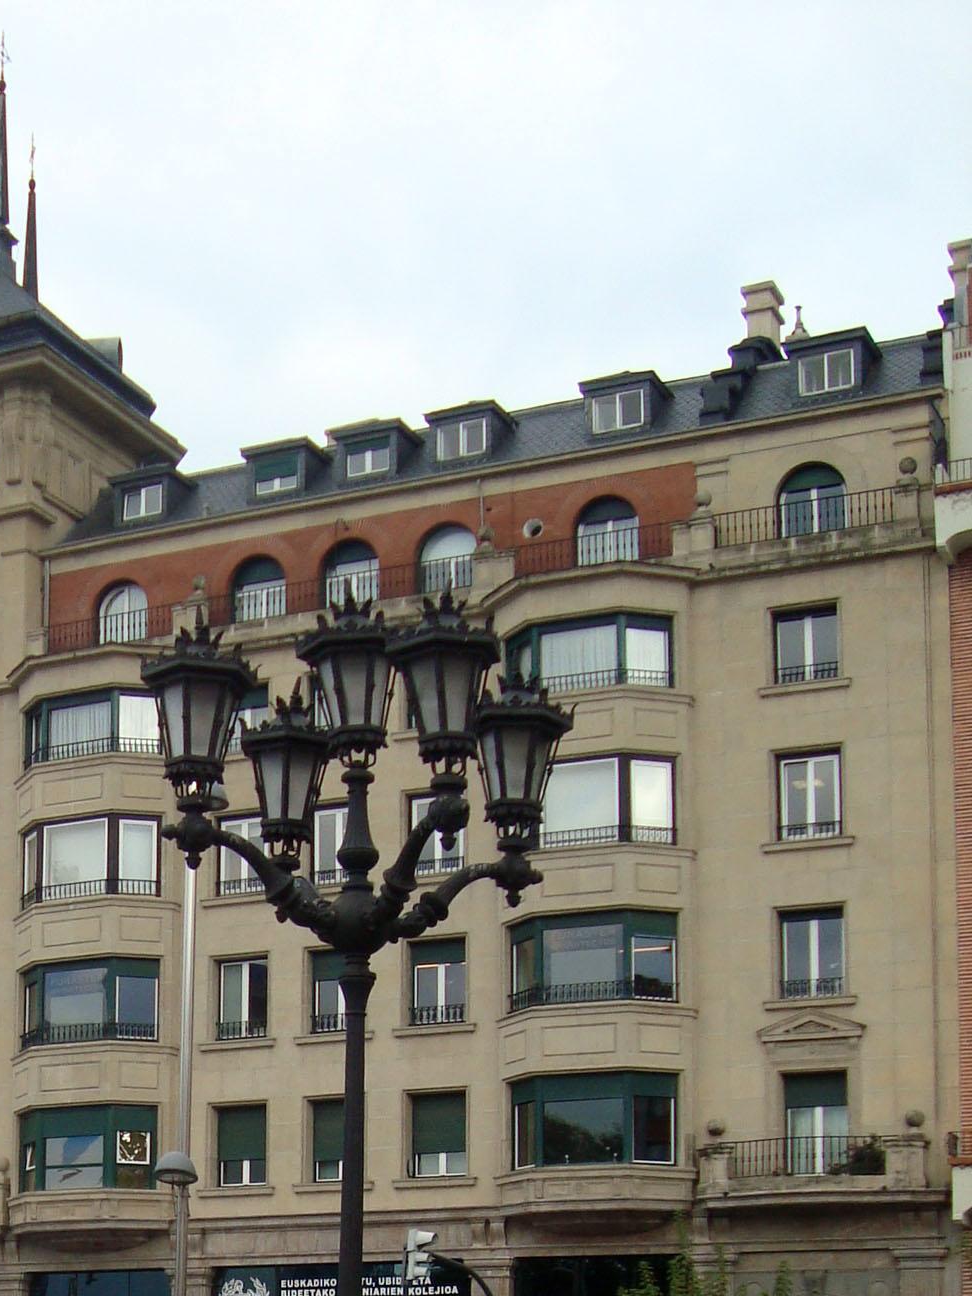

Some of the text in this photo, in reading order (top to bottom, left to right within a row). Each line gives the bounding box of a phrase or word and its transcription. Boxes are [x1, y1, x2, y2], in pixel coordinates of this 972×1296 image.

[280, 1278, 337, 1288] EUSKADIKO
[378, 1276, 402, 1286] UBID
[362, 1286, 404, 1296] NIARIEN
[408, 1286, 459, 1296] KOLEJIOA
